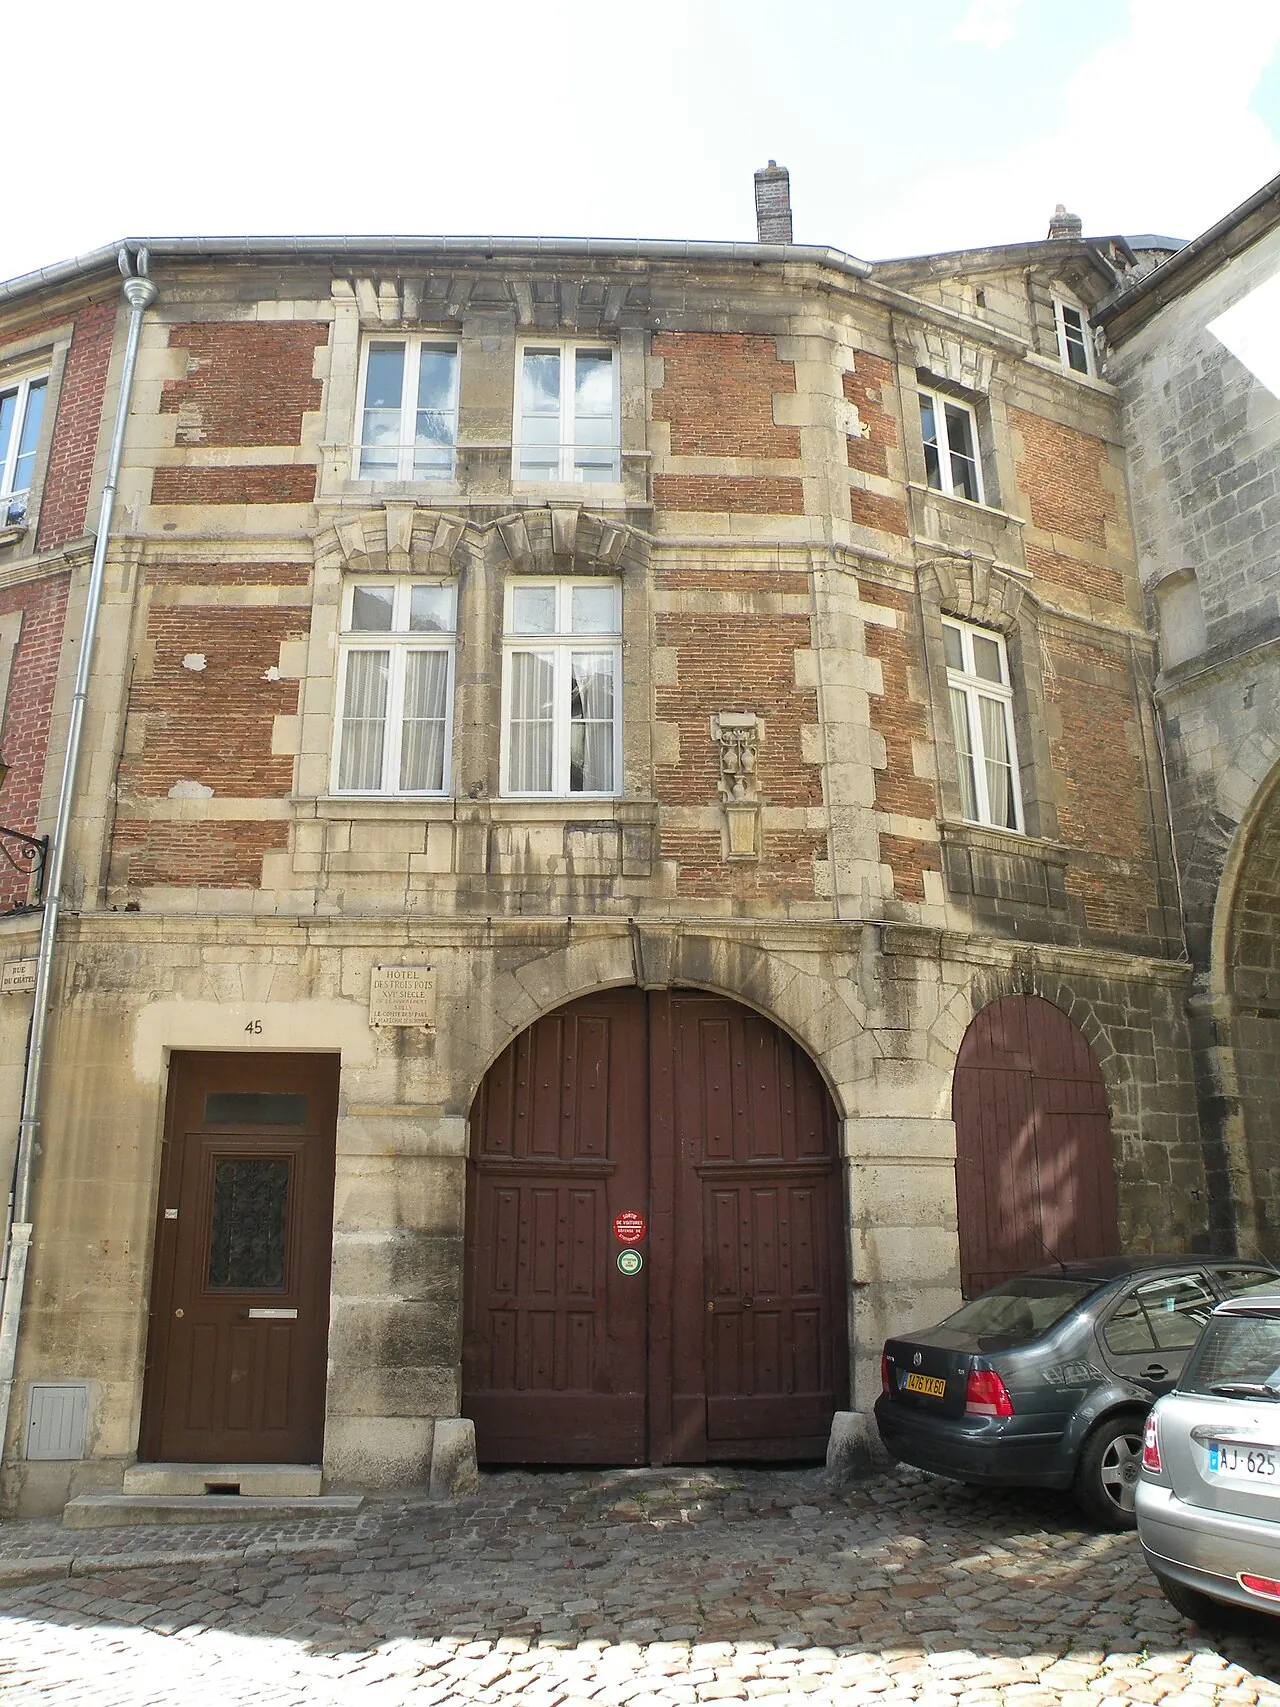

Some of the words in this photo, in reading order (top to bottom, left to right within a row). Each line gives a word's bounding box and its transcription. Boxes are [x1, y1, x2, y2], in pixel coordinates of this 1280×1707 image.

[12, 966, 26, 974] RUE
[386, 970, 419, 979] HÔTEL
[4, 977, 12, 985] DU
[374, 980, 389, 989] DES
[390, 980, 412, 989] TROIS
[414, 981, 433, 989] POTS
[244, 1019, 262, 1034] 45
[908, 1374, 924, 1390] 1476
[924, 1377, 935, 1392] YX
[934, 1380, 944, 1394] 60
